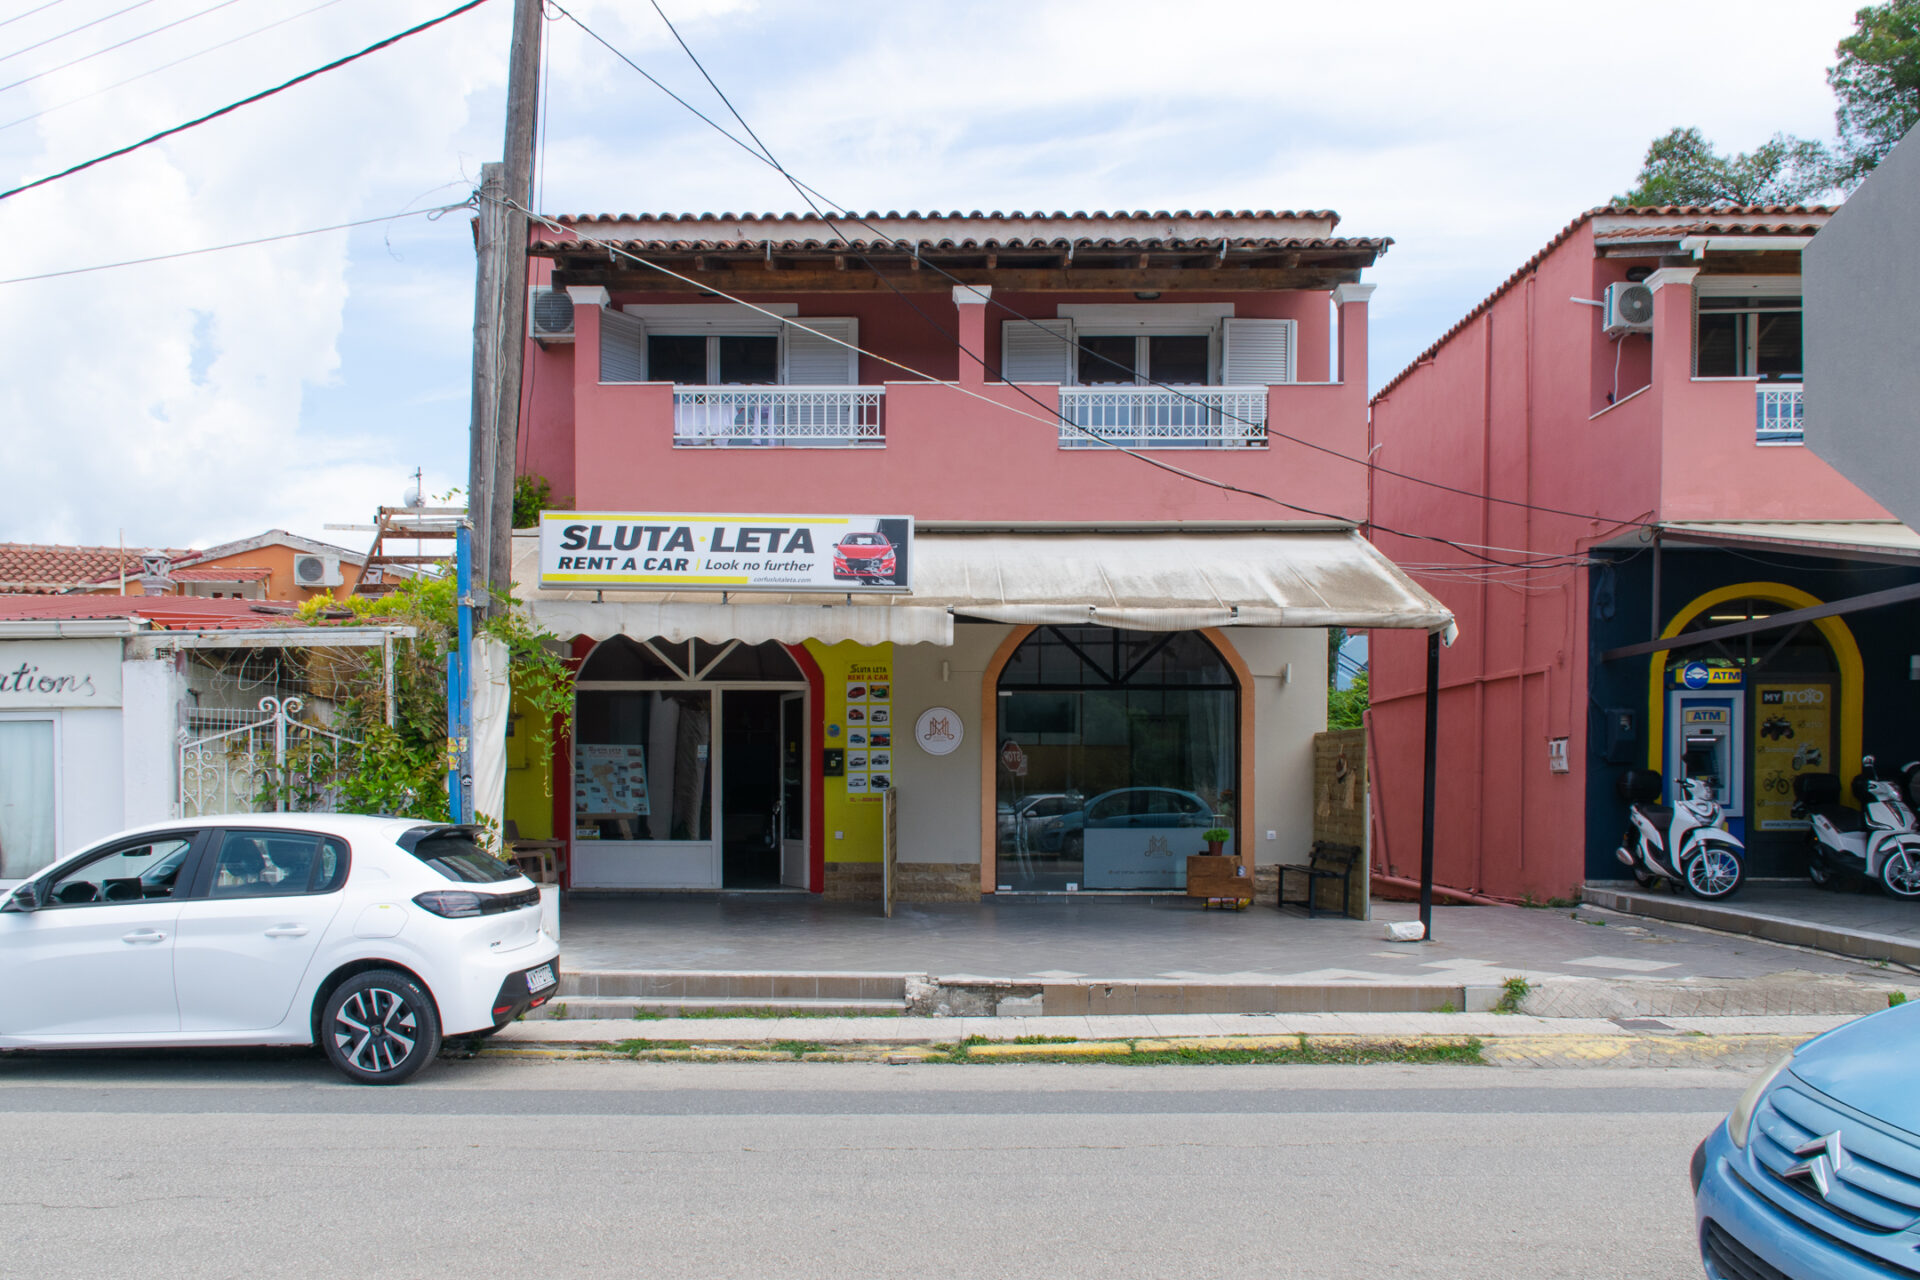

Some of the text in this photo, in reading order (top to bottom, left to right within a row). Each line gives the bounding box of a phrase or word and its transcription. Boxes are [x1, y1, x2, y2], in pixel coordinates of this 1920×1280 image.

[559, 524, 815, 553] SLUTA LETA
[558, 556, 690, 572] RENT A CAR
[705, 558, 815, 573] Look no further
[1712, 671, 1740, 680] ATM
[1763, 692, 1781, 702] MY
[1693, 711, 1721, 721] ATM
